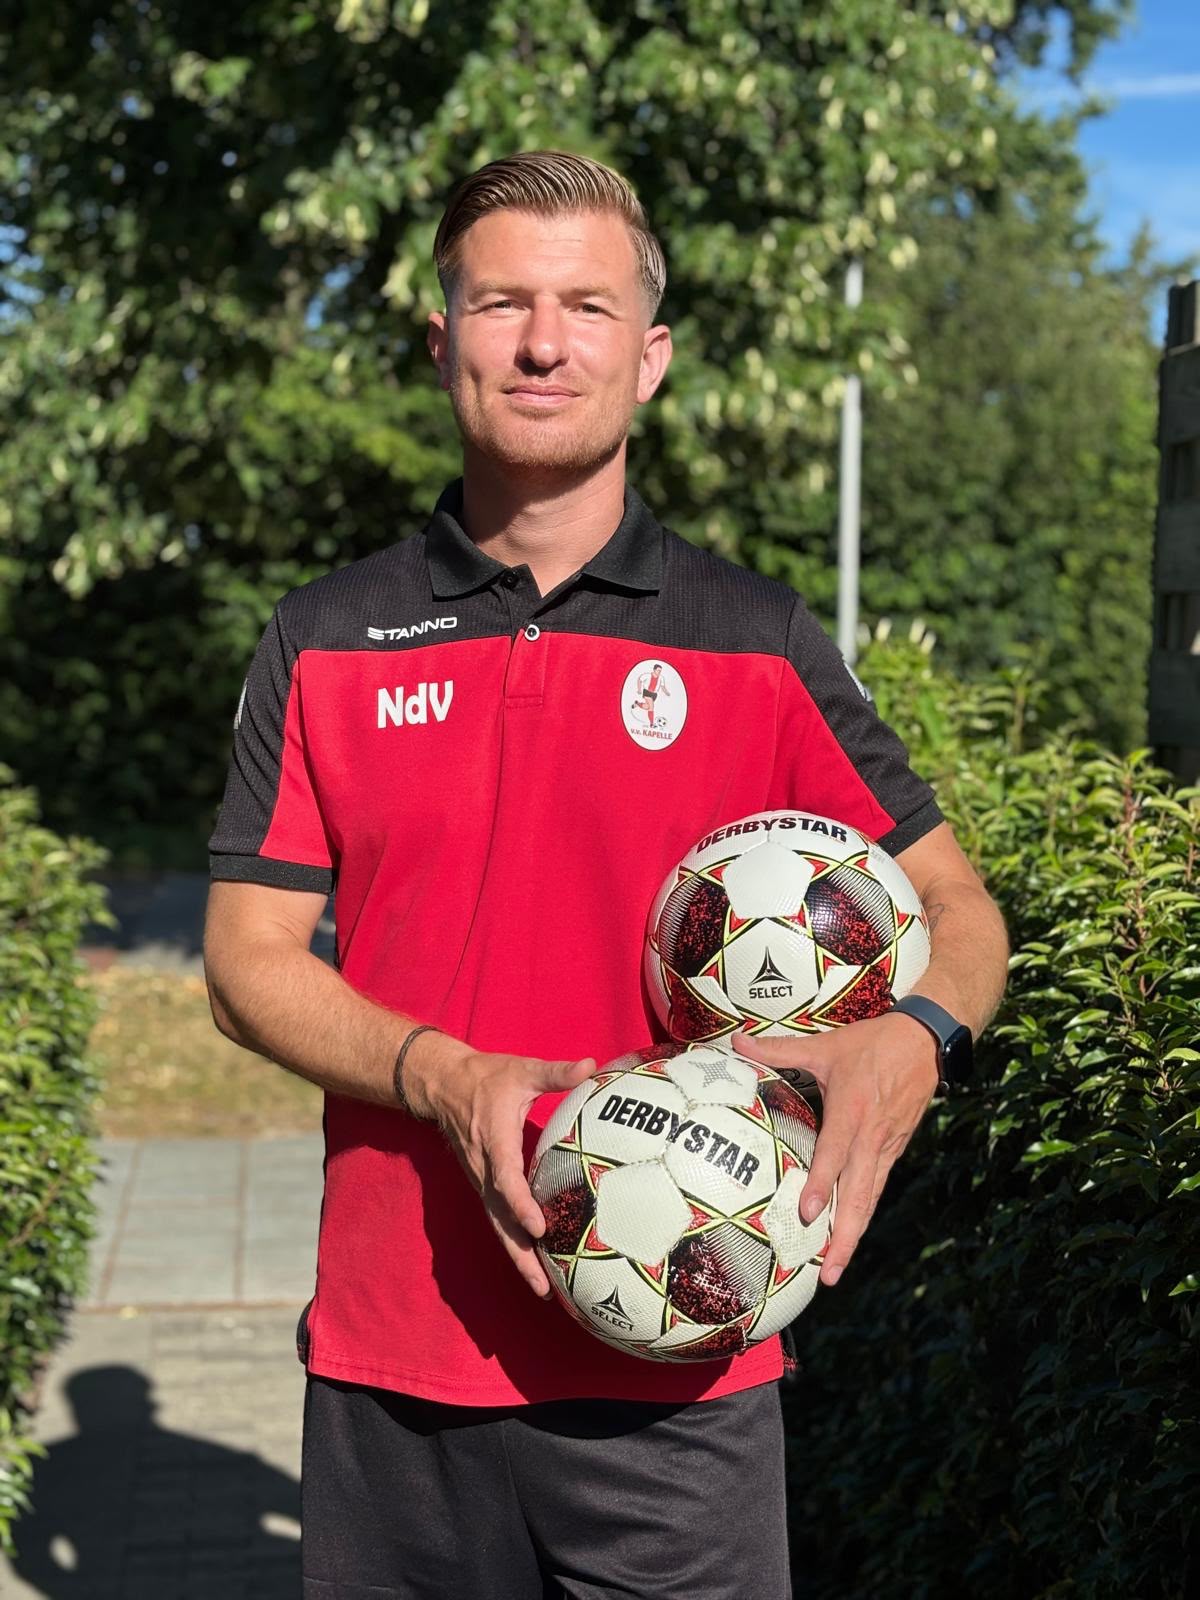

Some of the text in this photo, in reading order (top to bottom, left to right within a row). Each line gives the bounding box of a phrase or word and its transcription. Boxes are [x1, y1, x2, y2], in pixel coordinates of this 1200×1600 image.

[367, 616, 458, 641] STANNO
[377, 680, 454, 729] NdV
[642, 729, 673, 740] KAPELLE
[696, 817, 848, 854] DERBYSTAR
[748, 985, 793, 999] SELECT
[597, 1094, 760, 1187] DERBYSTAR
[591, 1306, 634, 1331] SELECT
